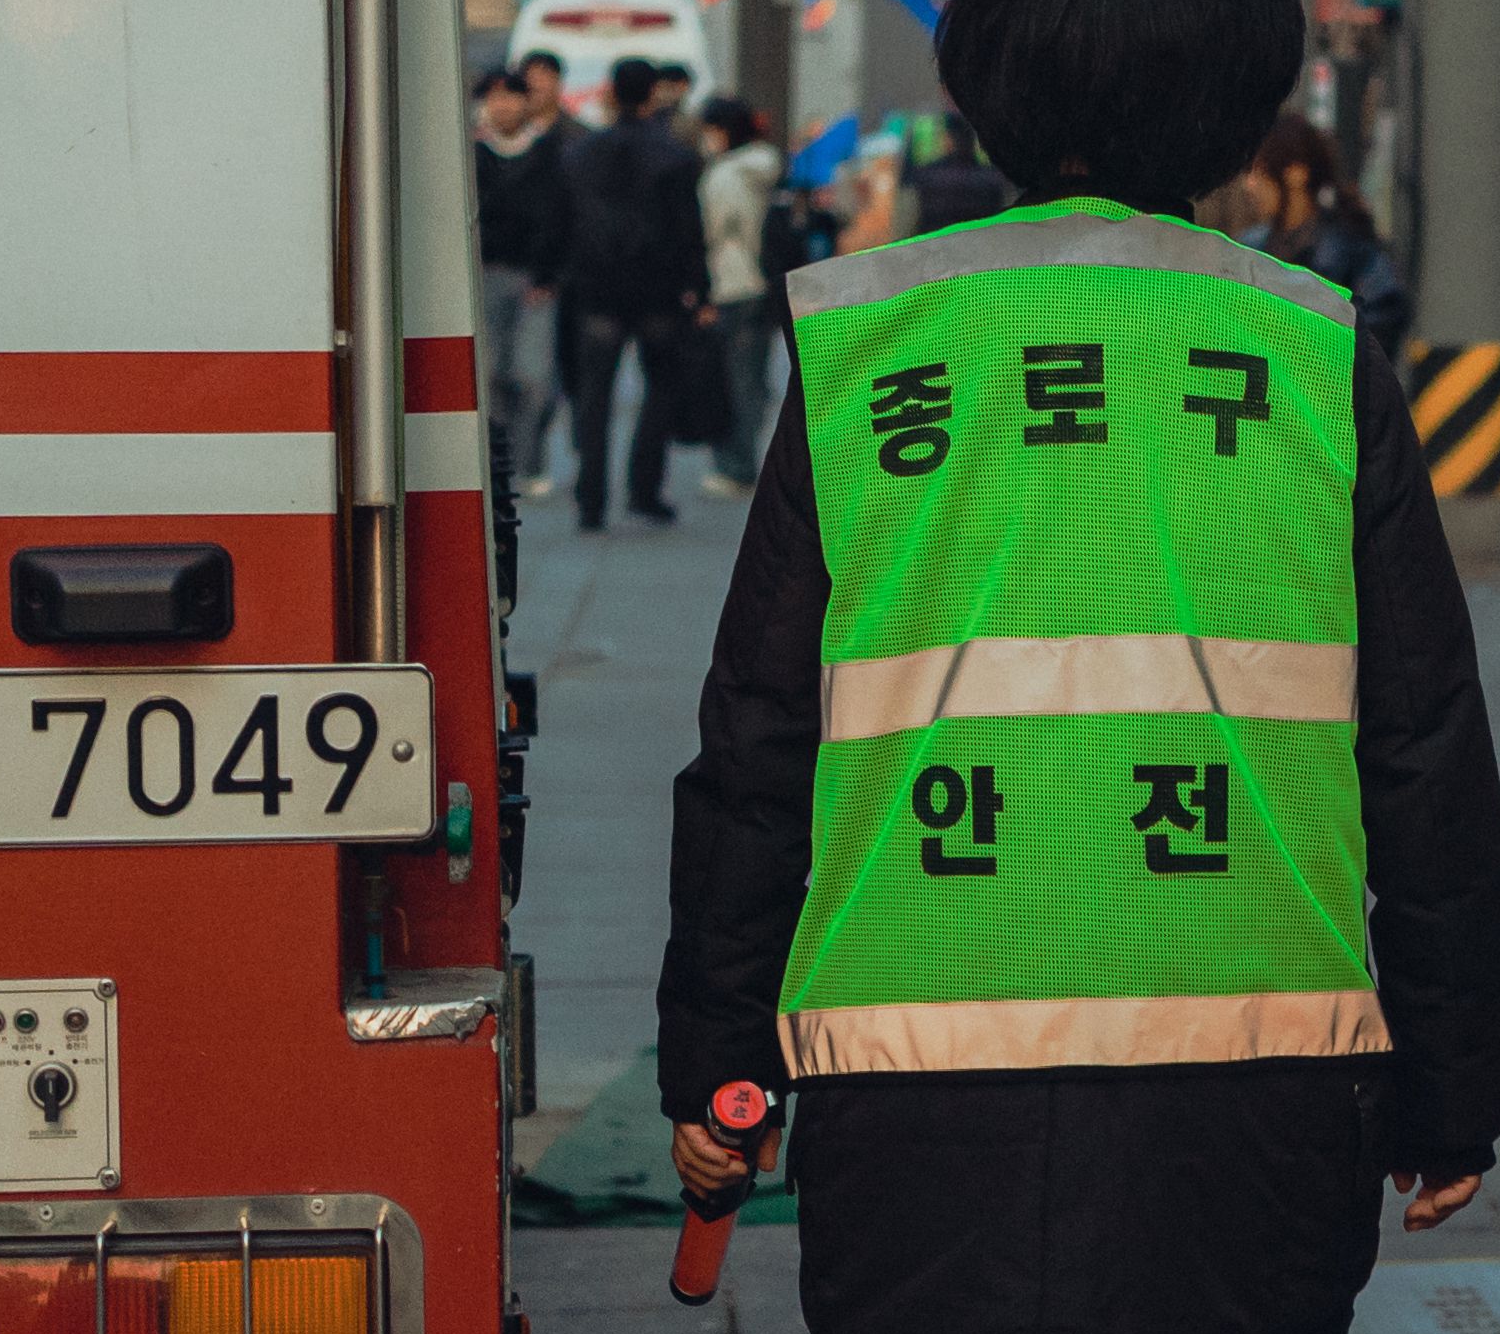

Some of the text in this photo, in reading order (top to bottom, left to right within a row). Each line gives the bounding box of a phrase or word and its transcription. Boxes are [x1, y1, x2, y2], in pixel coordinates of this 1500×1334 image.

[869, 342, 1272, 478] 종로구
[31, 692, 380, 820] 7049
[911, 763, 1230, 877] 안전
